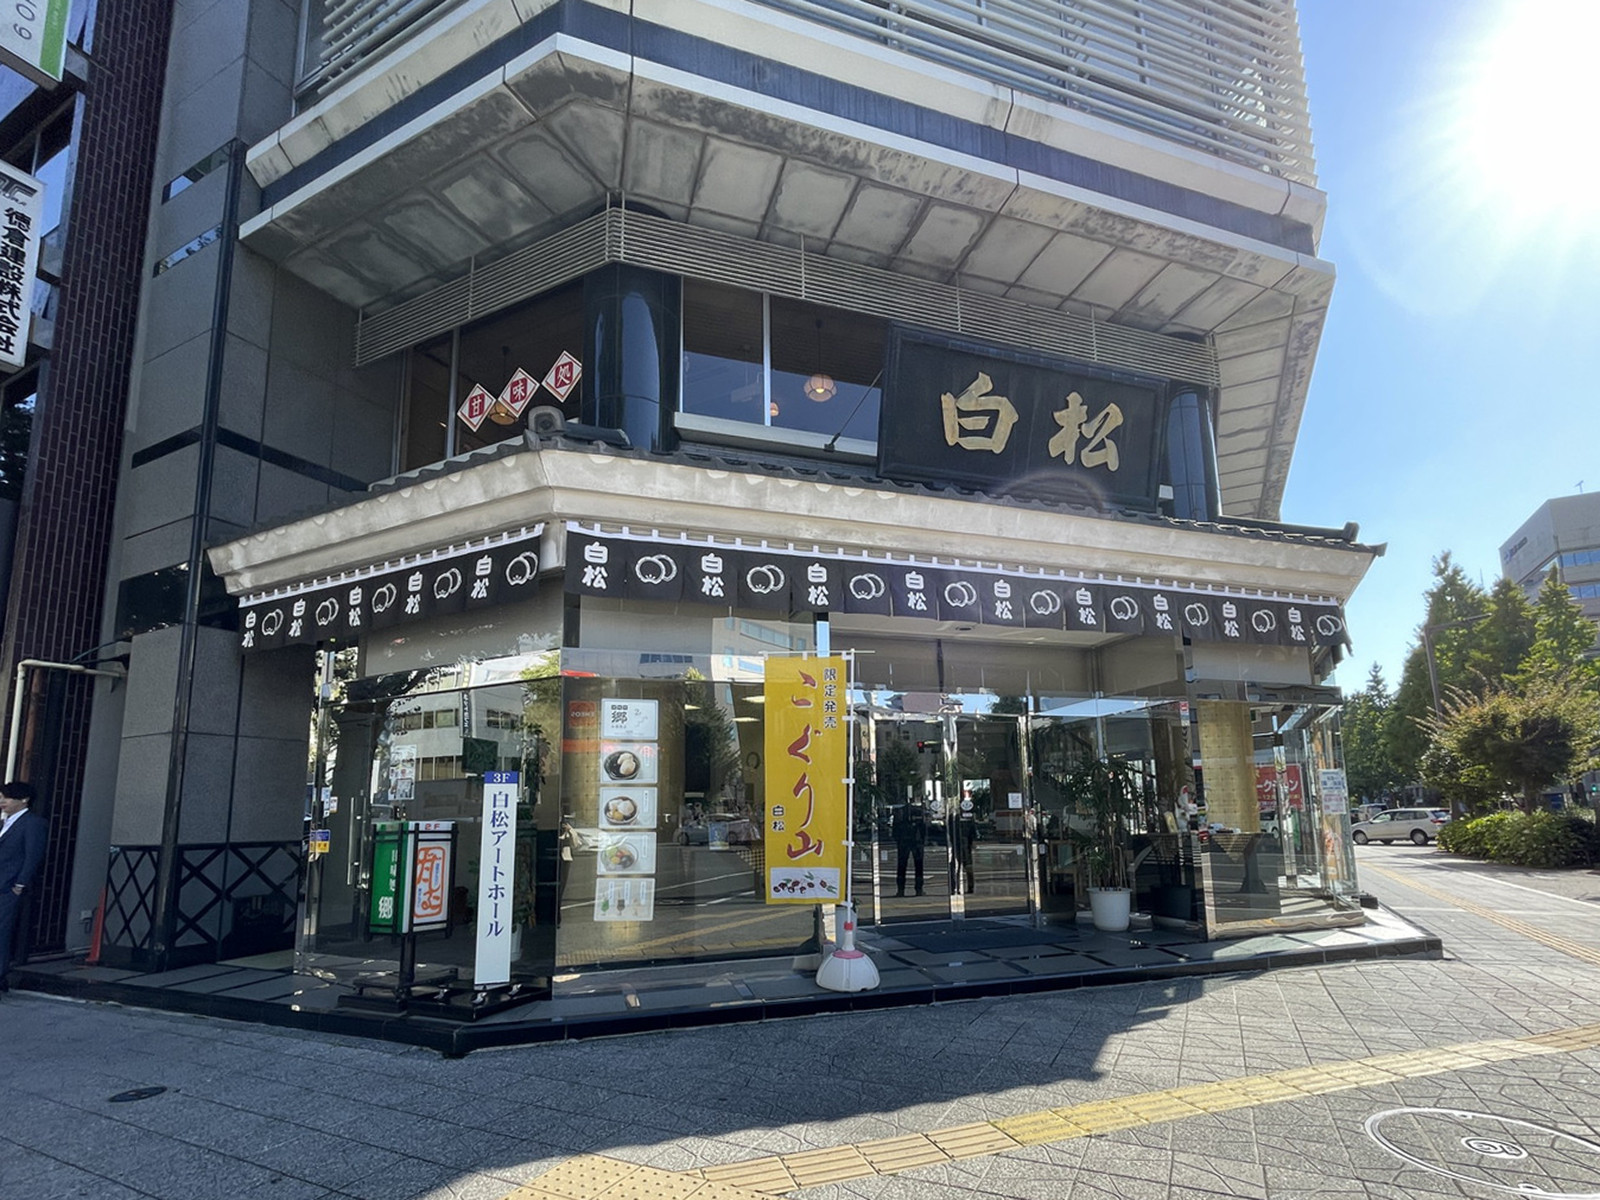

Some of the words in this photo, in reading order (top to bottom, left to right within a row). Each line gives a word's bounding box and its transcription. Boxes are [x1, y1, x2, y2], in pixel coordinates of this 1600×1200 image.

[469, 362, 574, 418] 甘味処
[941, 372, 1123, 471] 白松
[471, 554, 492, 599] 白松
[582, 541, 609, 590] 白松
[701, 552, 724, 598] 白松
[807, 562, 829, 607] 白松
[349, 585, 362, 627] 白松
[405, 571, 423, 615] 白松
[905, 571, 928, 612] 白松
[993, 579, 1013, 620] 白松
[1075, 587, 1097, 626] 白松
[1152, 593, 1173, 631] 白松
[242, 610, 256, 648] 白松
[289, 598, 306, 637] 白松
[1222, 601, 1240, 638] 白松
[1287, 607, 1305, 641] 白松
[823, 668, 837, 729] 限定発売
[493, 772, 511, 783] 3F
[772, 805, 785, 832] 白松
[486, 791, 509, 938] 白松アートホール
